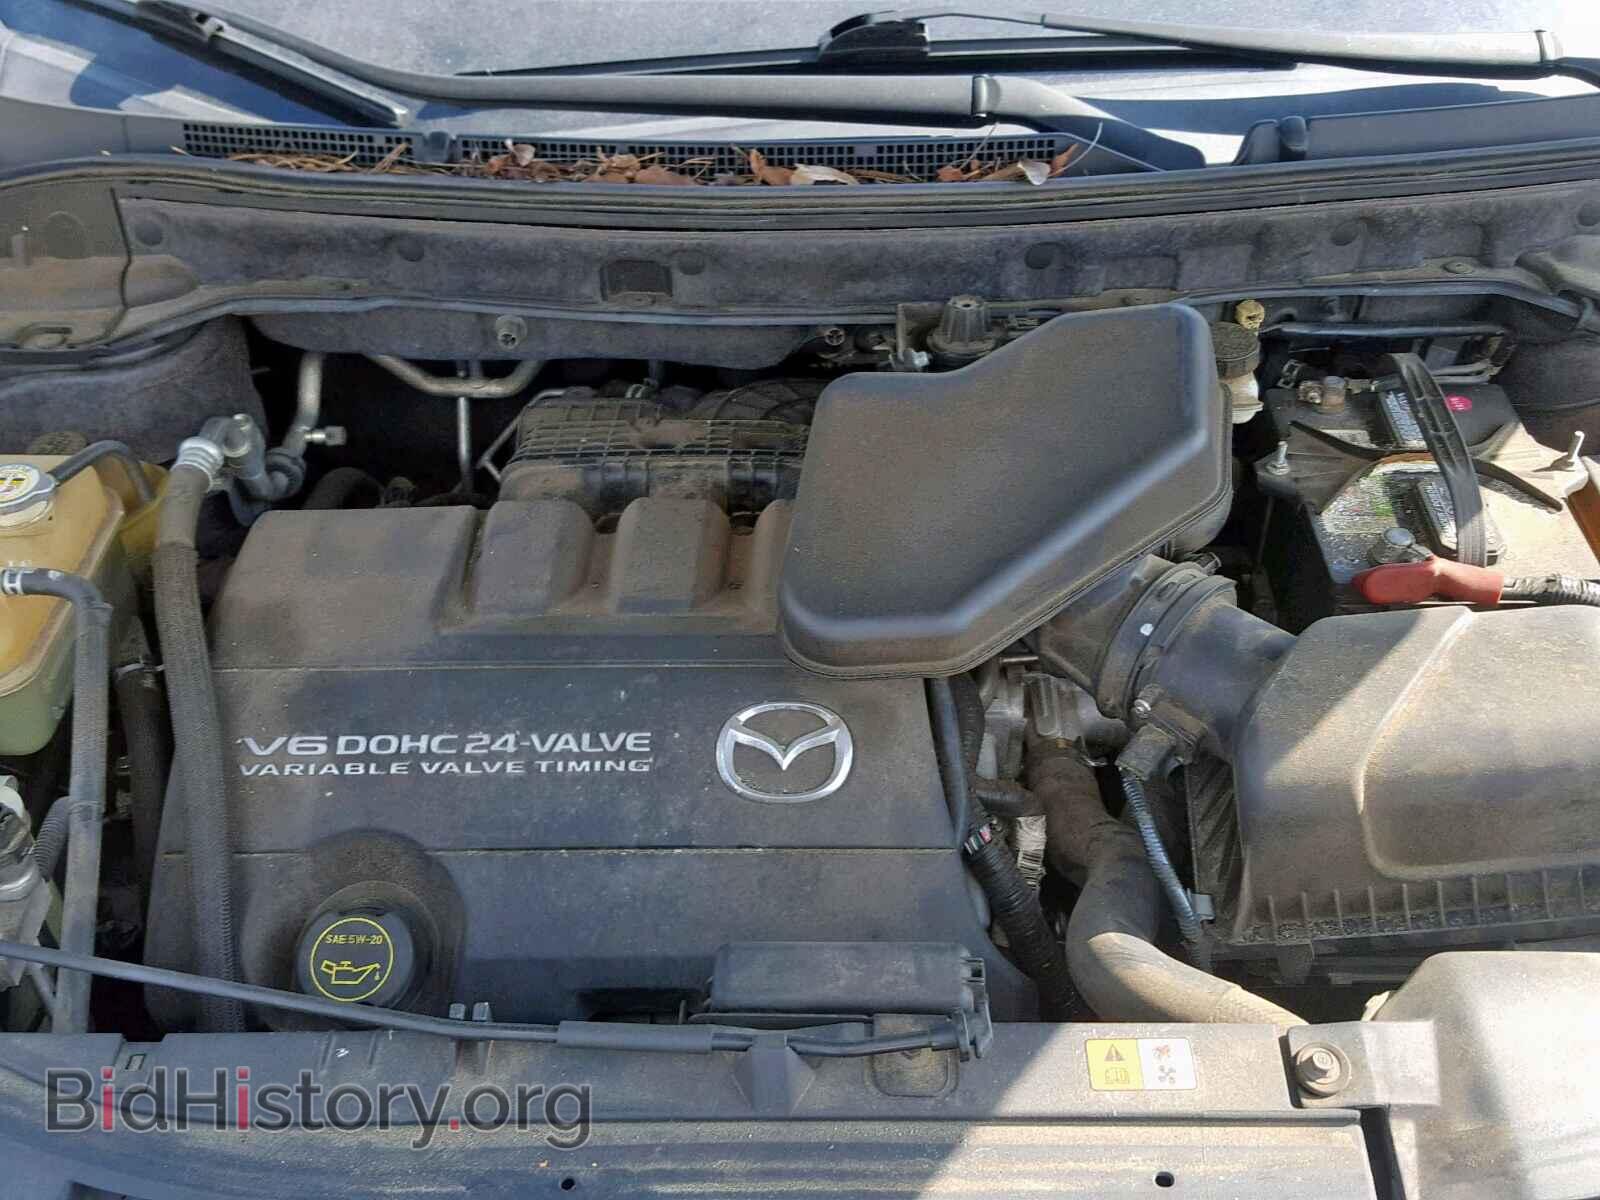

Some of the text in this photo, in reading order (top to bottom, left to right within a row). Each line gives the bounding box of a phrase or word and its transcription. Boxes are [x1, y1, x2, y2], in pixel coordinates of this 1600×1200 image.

[239, 732, 651, 756] V6 DOHC 24-VALVE
[239, 760, 652, 776] VARIABLE VALVE TIMING
[325, 934, 383, 945] SAE 5W-20
